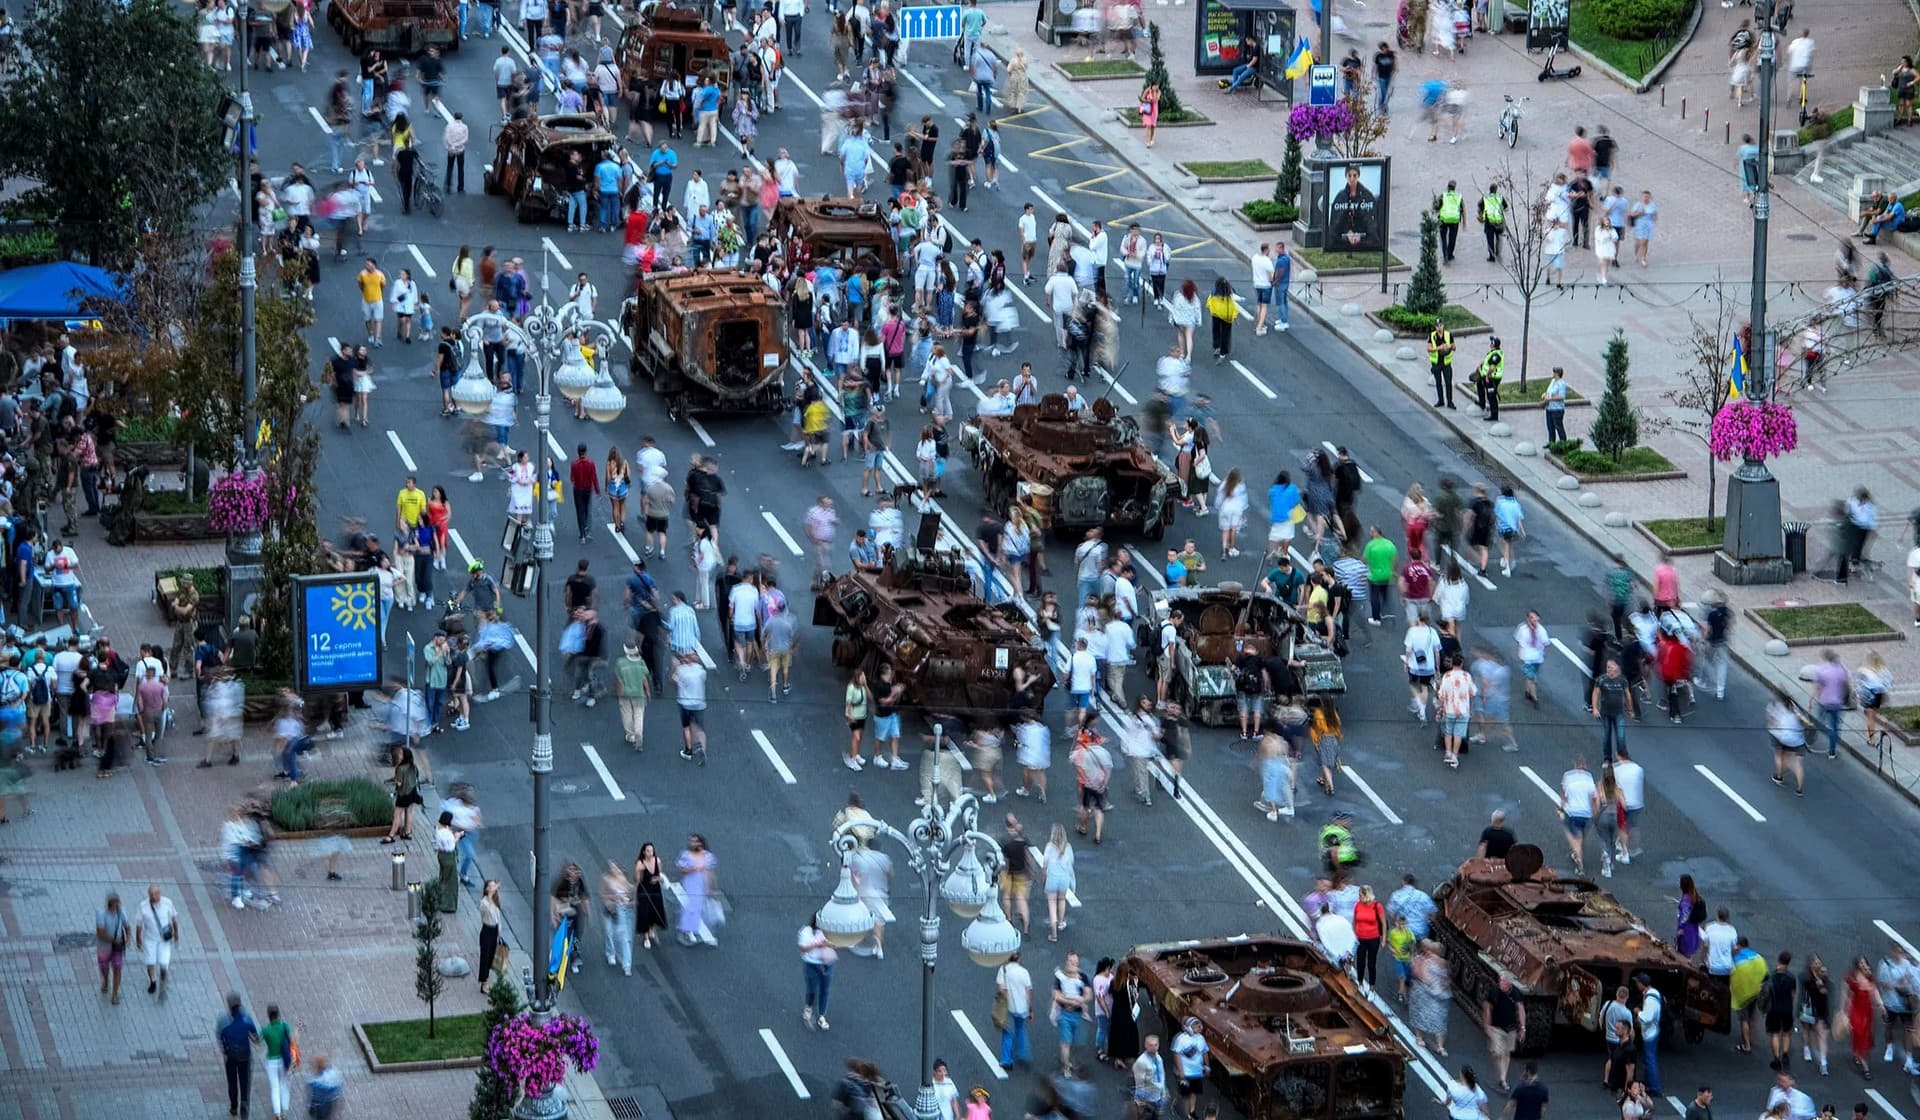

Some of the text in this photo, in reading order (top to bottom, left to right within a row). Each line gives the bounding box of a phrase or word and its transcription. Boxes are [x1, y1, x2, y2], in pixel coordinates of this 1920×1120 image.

[1334, 201, 1374, 210] ONE BY ONE
[310, 632, 331, 652] 12
